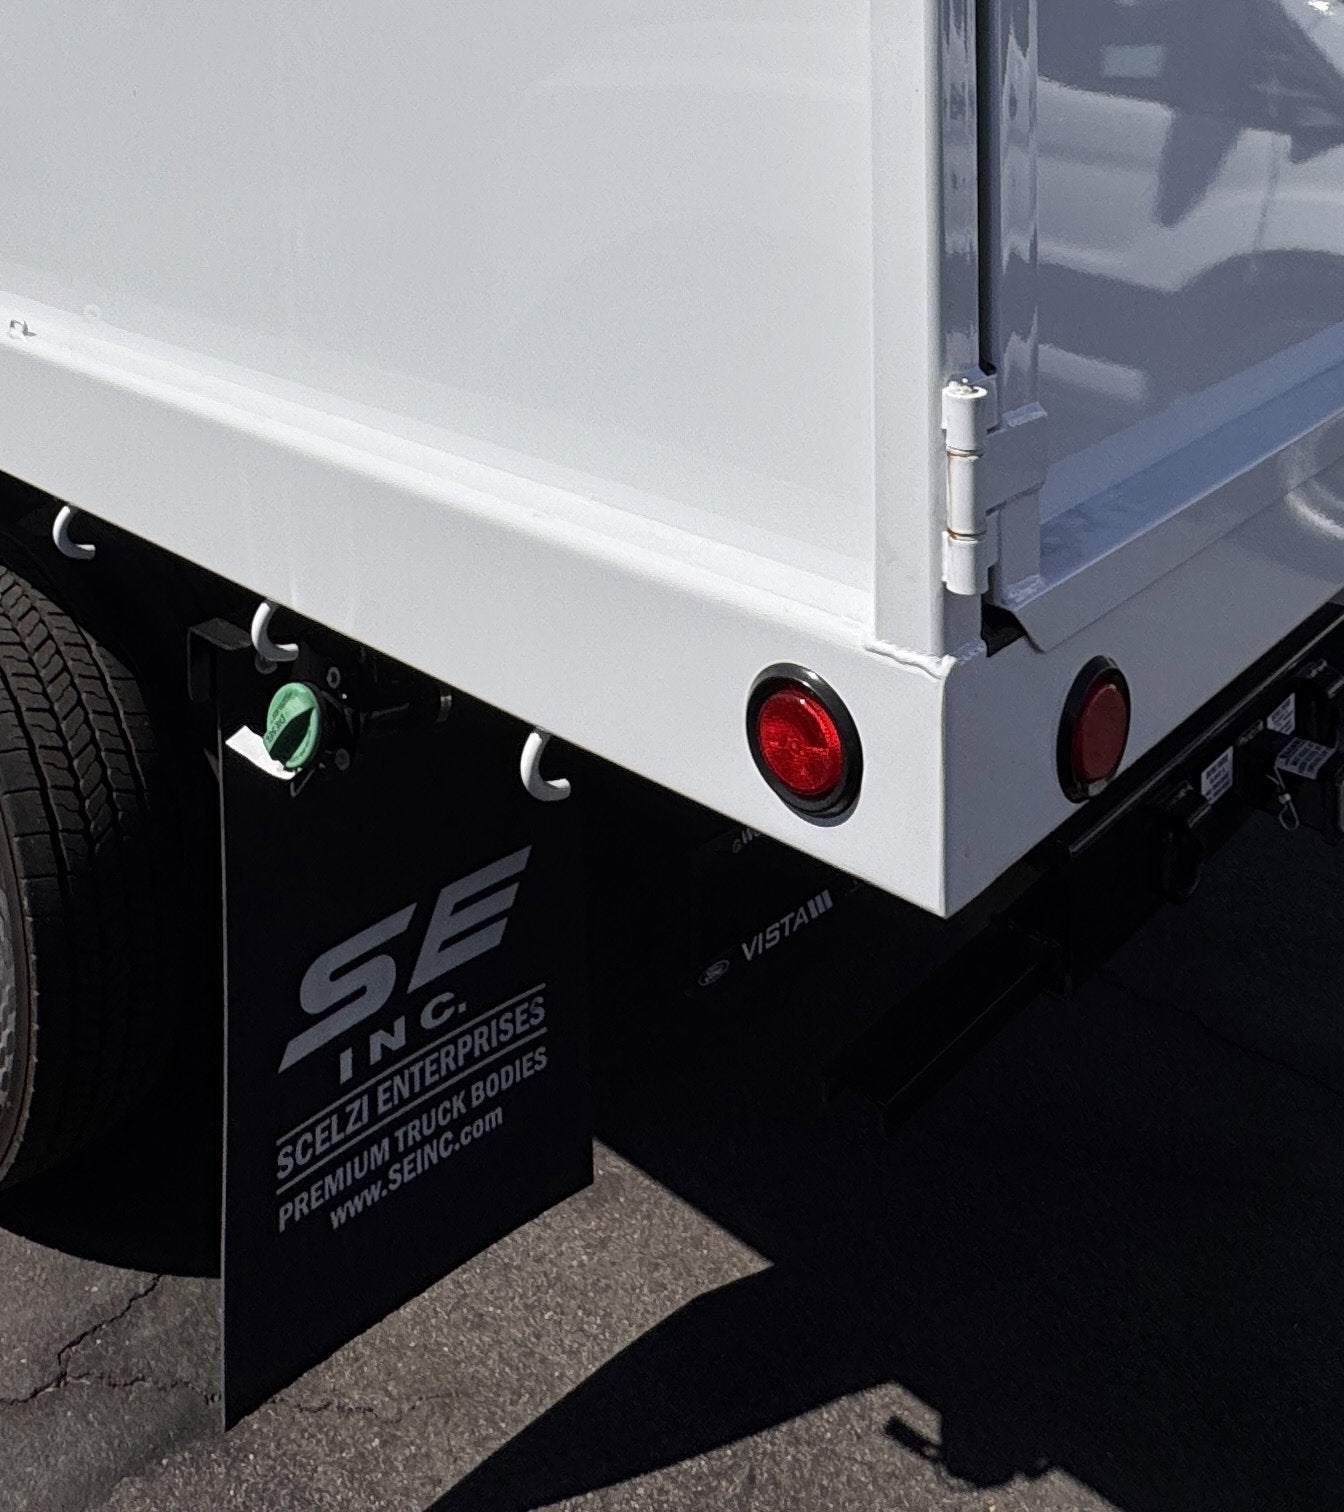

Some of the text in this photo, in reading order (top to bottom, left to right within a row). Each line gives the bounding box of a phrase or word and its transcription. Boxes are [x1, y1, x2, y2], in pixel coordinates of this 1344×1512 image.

[278, 844, 532, 1074] SE
[740, 906, 809, 961] VISTA
[276, 996, 545, 1179] SCELZI ENTERPRISES
[339, 991, 467, 1085] INC.
[278, 1046, 548, 1233] PREMIUM TRUCK BODIES
[329, 1106, 503, 1230] www.SEINC.com
